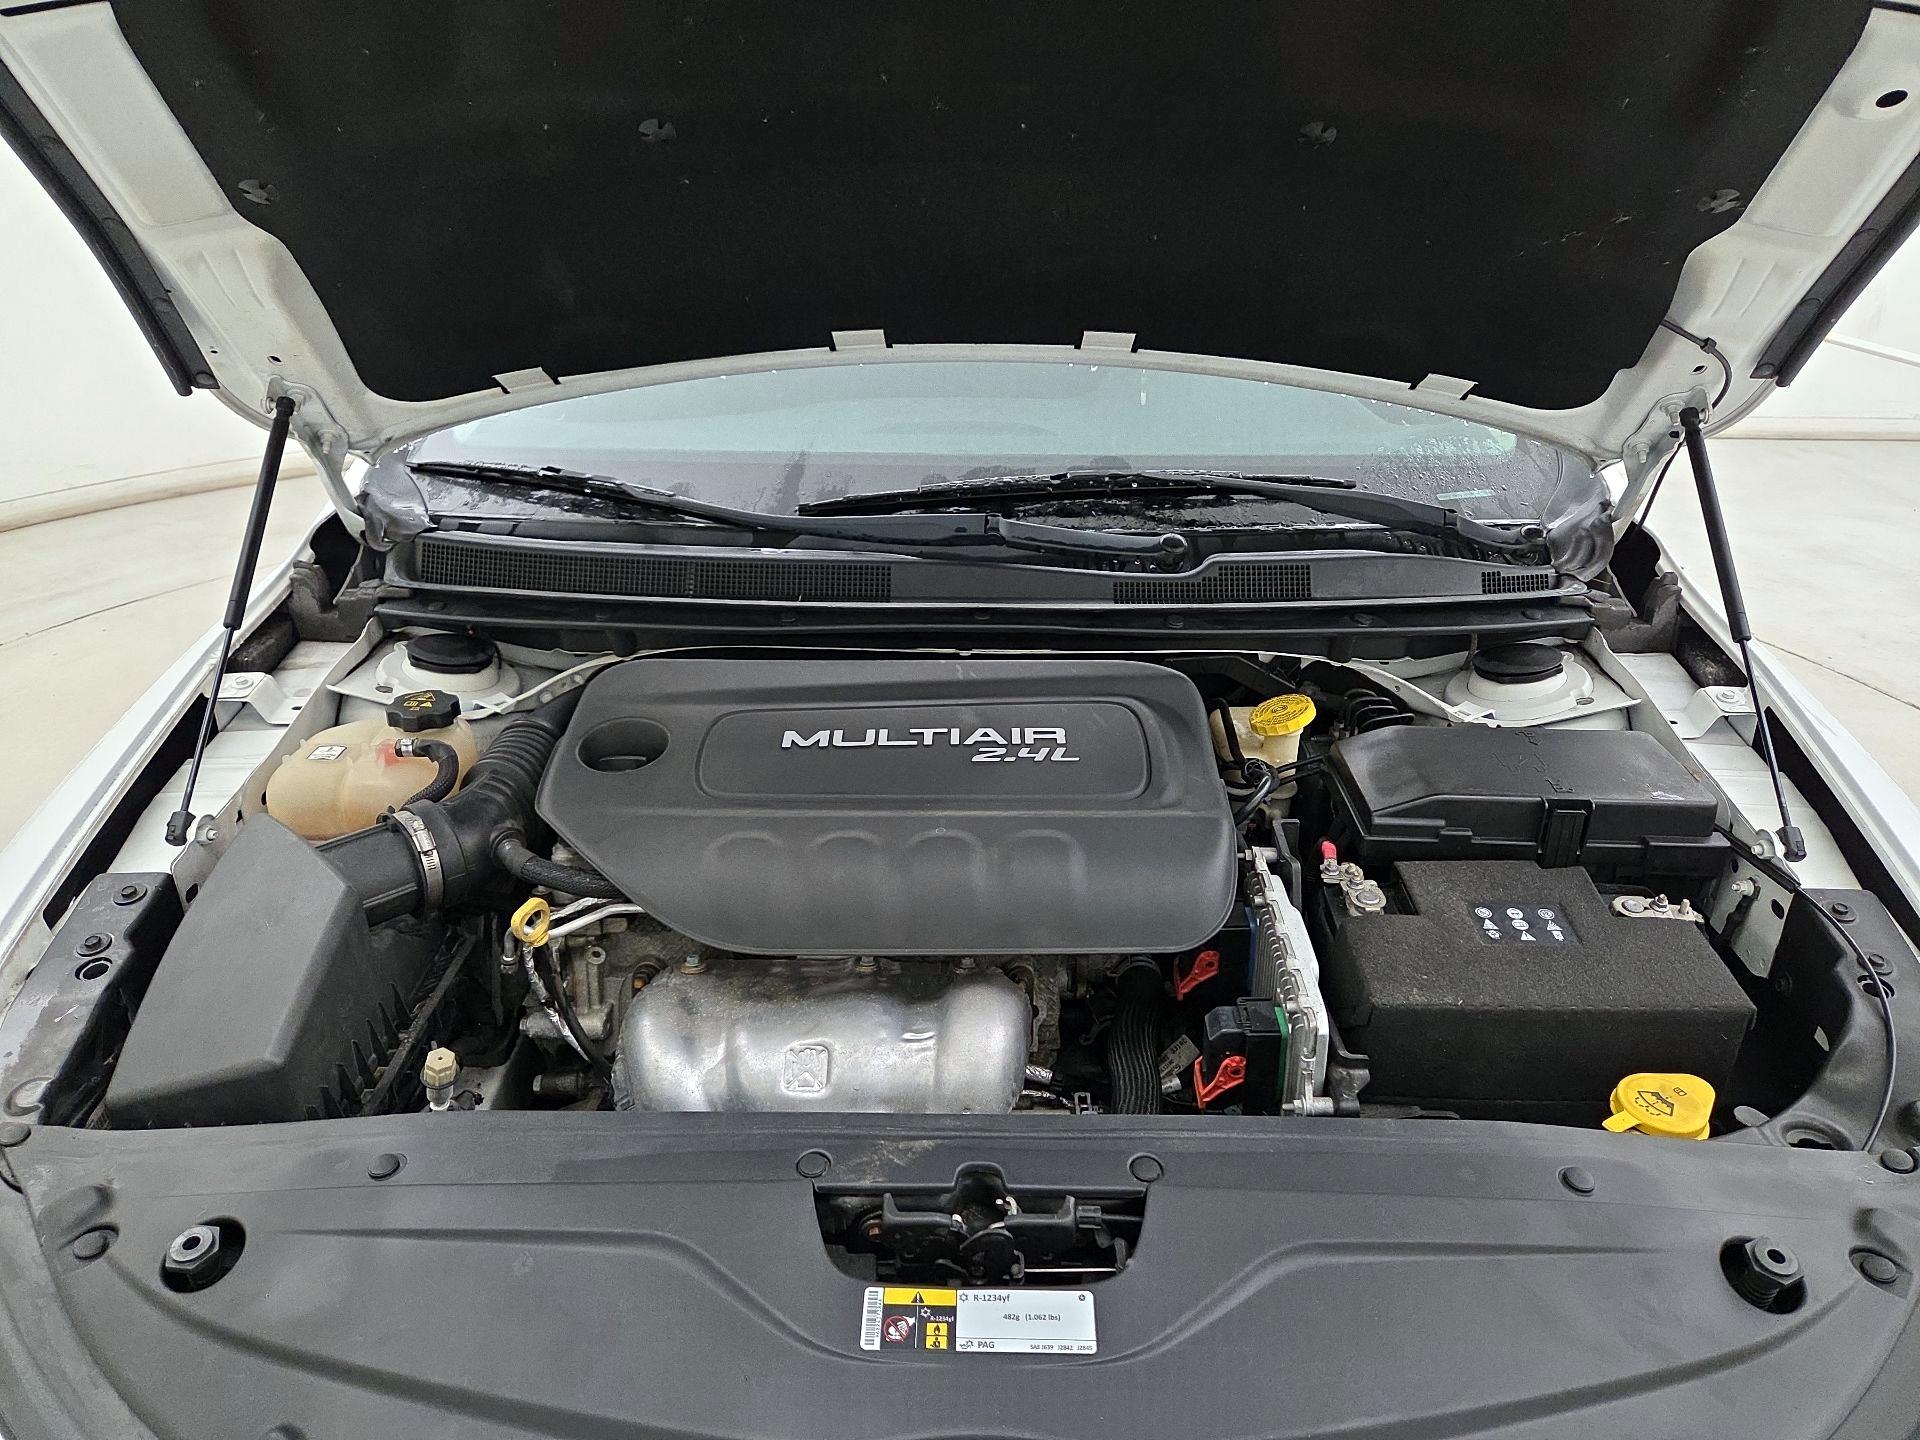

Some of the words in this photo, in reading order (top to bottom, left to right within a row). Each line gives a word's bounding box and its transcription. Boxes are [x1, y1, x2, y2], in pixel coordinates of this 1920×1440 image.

[781, 727, 1067, 748] MULTIAIR
[971, 747, 1081, 762] 2.4L
[973, 1293, 1011, 1304] R-1234yf
[1003, 1313, 1021, 1322] 482g
[1025, 1313, 1047, 1322] (1.062
[1048, 1313, 1061, 1322] lbs)
[977, 1340, 996, 1349] PAG
